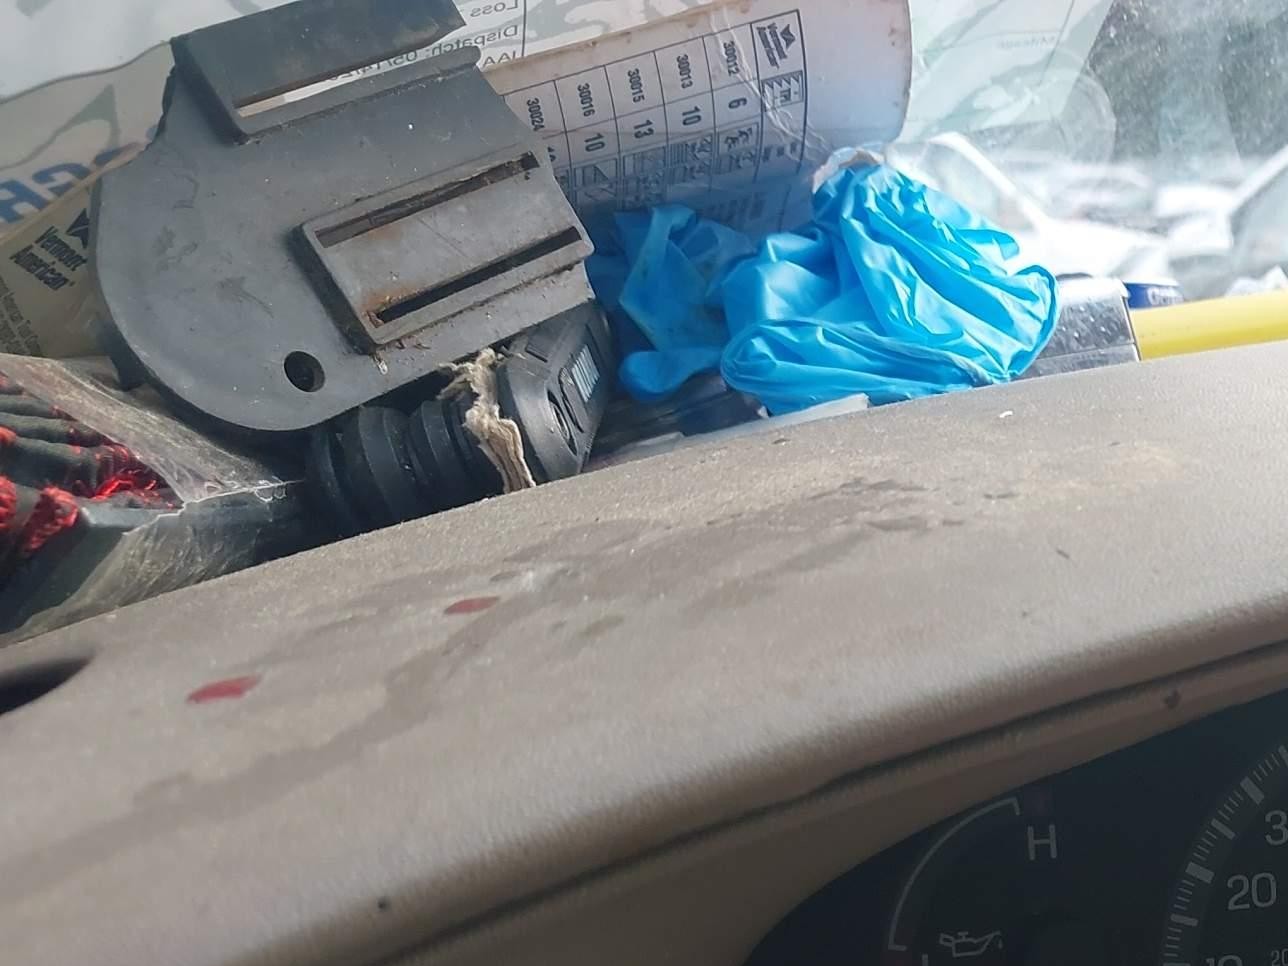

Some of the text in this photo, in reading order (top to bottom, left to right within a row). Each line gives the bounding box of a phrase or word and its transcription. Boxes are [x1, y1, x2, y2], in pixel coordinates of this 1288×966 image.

[676, 53, 694, 89] 30013
[723, 40, 740, 77] 30012
[577, 82, 596, 117] 30016
[627, 68, 646, 103] 30015
[526, 97, 546, 132] 30024
[681, 105, 702, 126] 10
[728, 97, 748, 110] 6
[584, 133, 605, 153] 10
[633, 119, 655, 139] 13
[1027, 823, 1058, 861] H
[1226, 872, 1278, 911] 20
